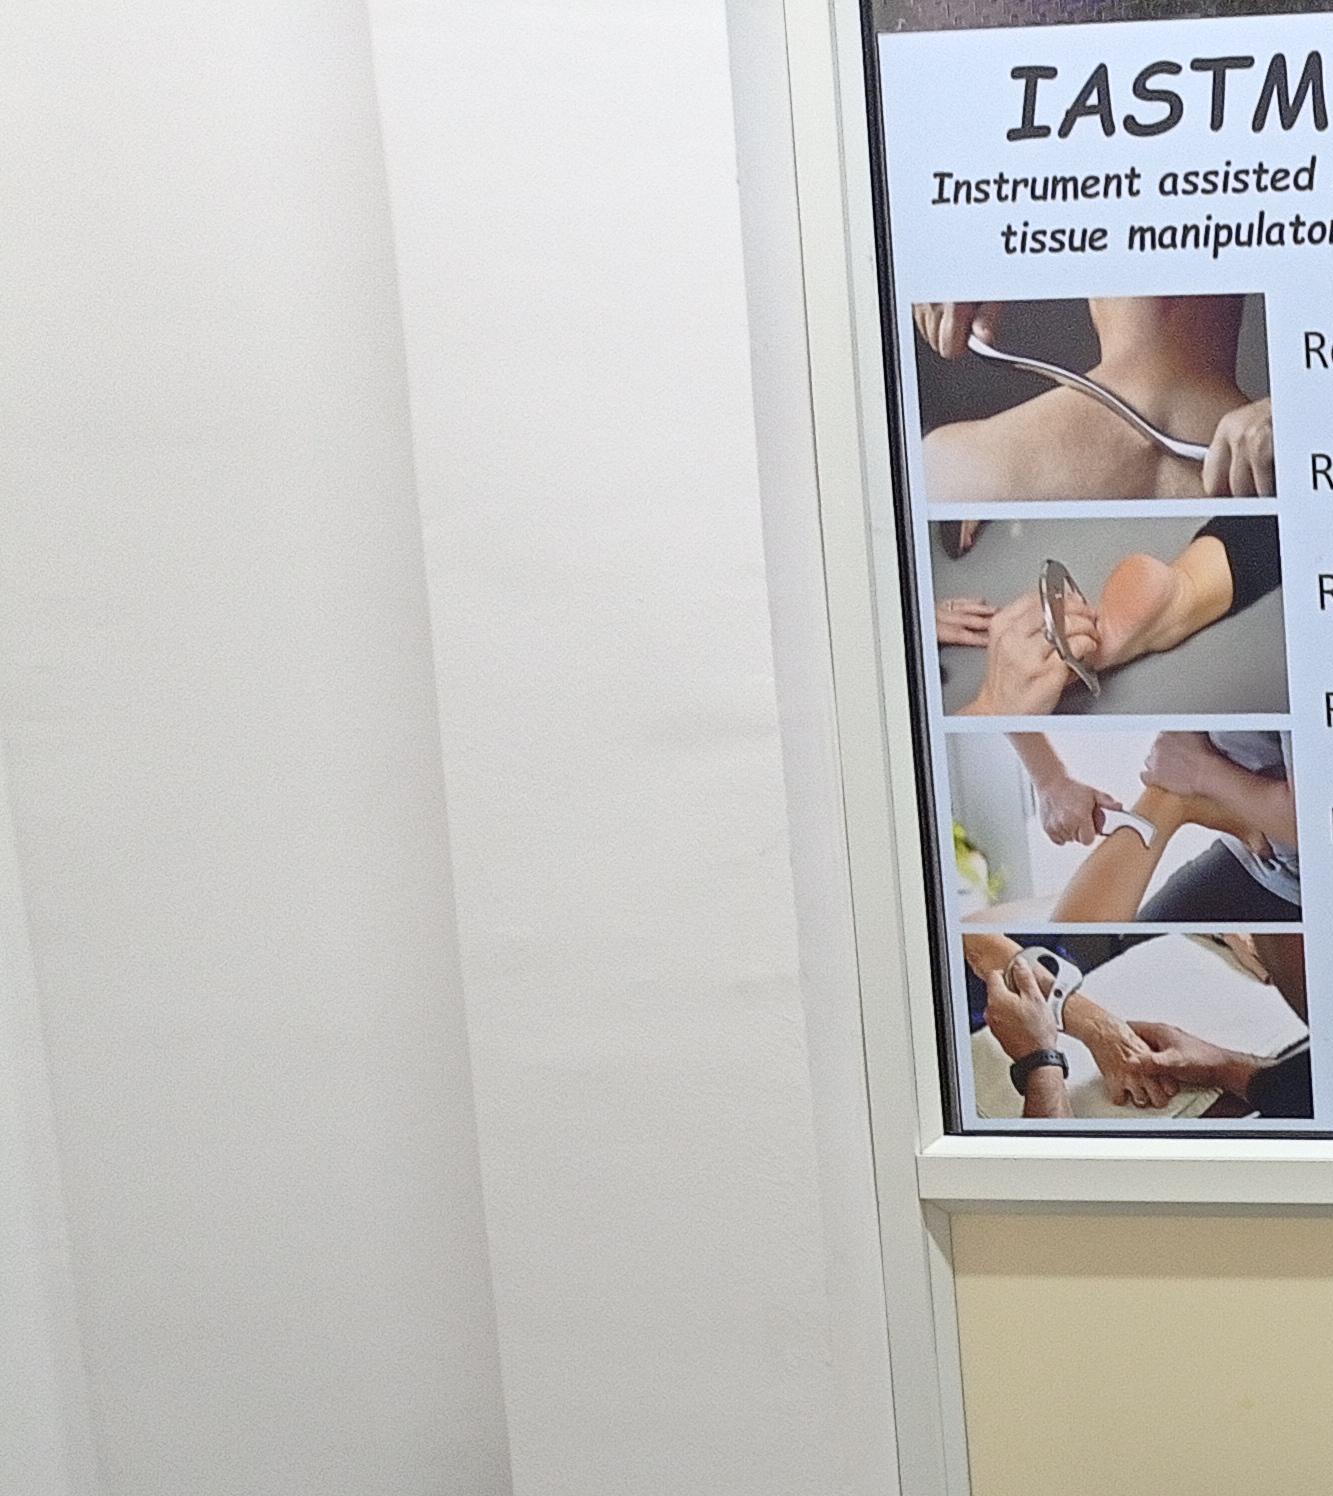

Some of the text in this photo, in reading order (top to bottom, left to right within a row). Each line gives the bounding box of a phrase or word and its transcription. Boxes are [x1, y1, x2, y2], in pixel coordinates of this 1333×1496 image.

[1007, 51, 1328, 141] IASTM
[932, 167, 1141, 205] Instrument
[1159, 155, 1316, 196] assisted
[1001, 221, 1107, 254] tissue
